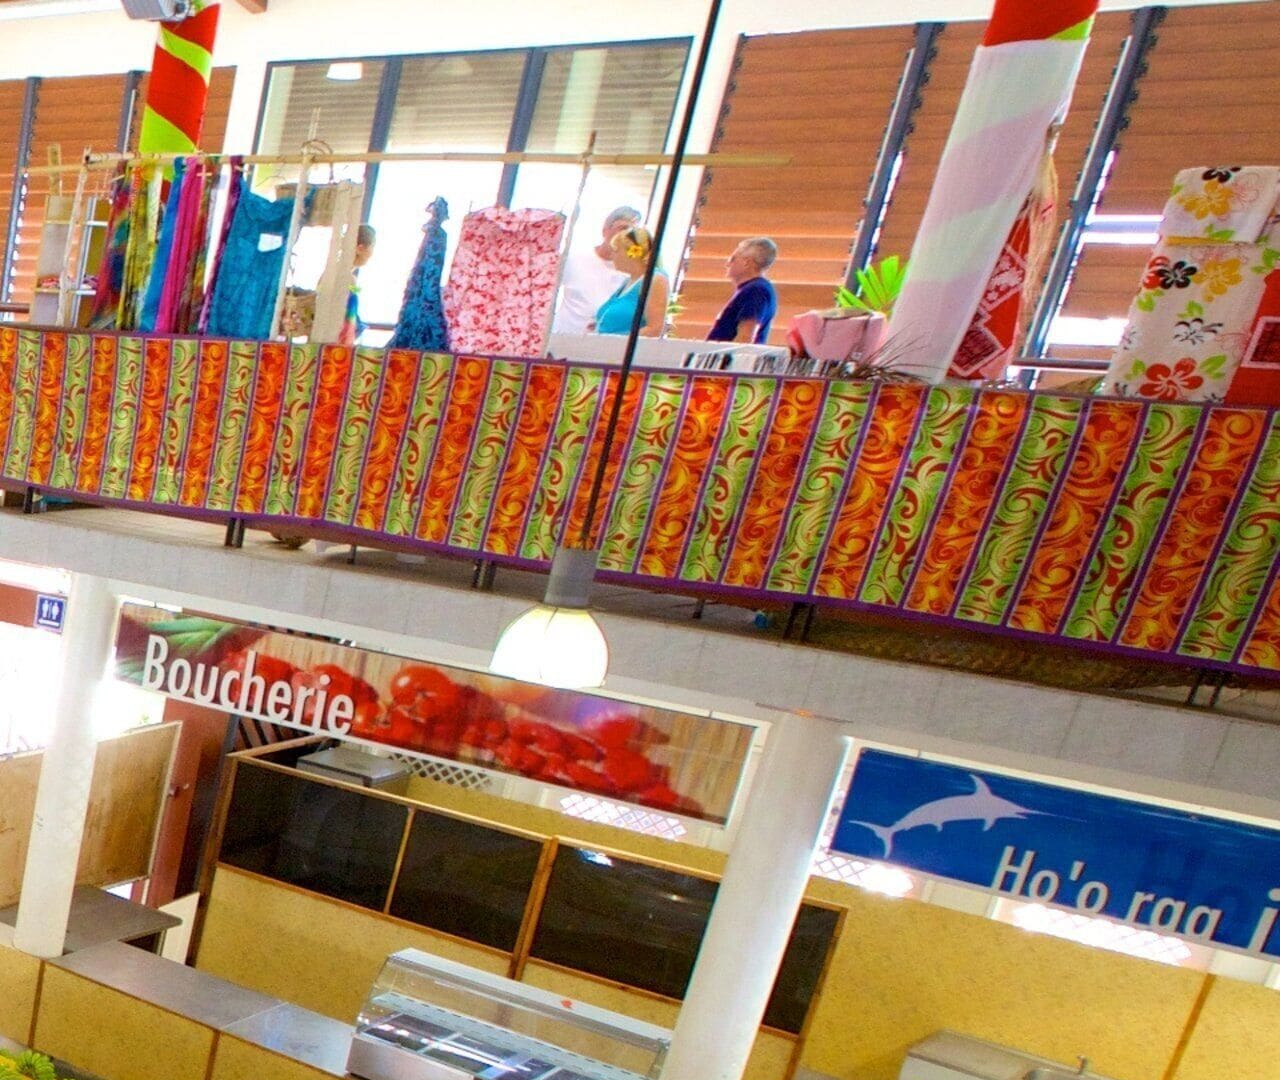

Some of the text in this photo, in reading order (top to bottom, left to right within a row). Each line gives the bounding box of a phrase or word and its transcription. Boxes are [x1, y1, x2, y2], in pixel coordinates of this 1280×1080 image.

[142, 633, 354, 736] Boucherie
[990, 845, 1110, 914] Ho'o
[1126, 890, 1223, 942] raa
